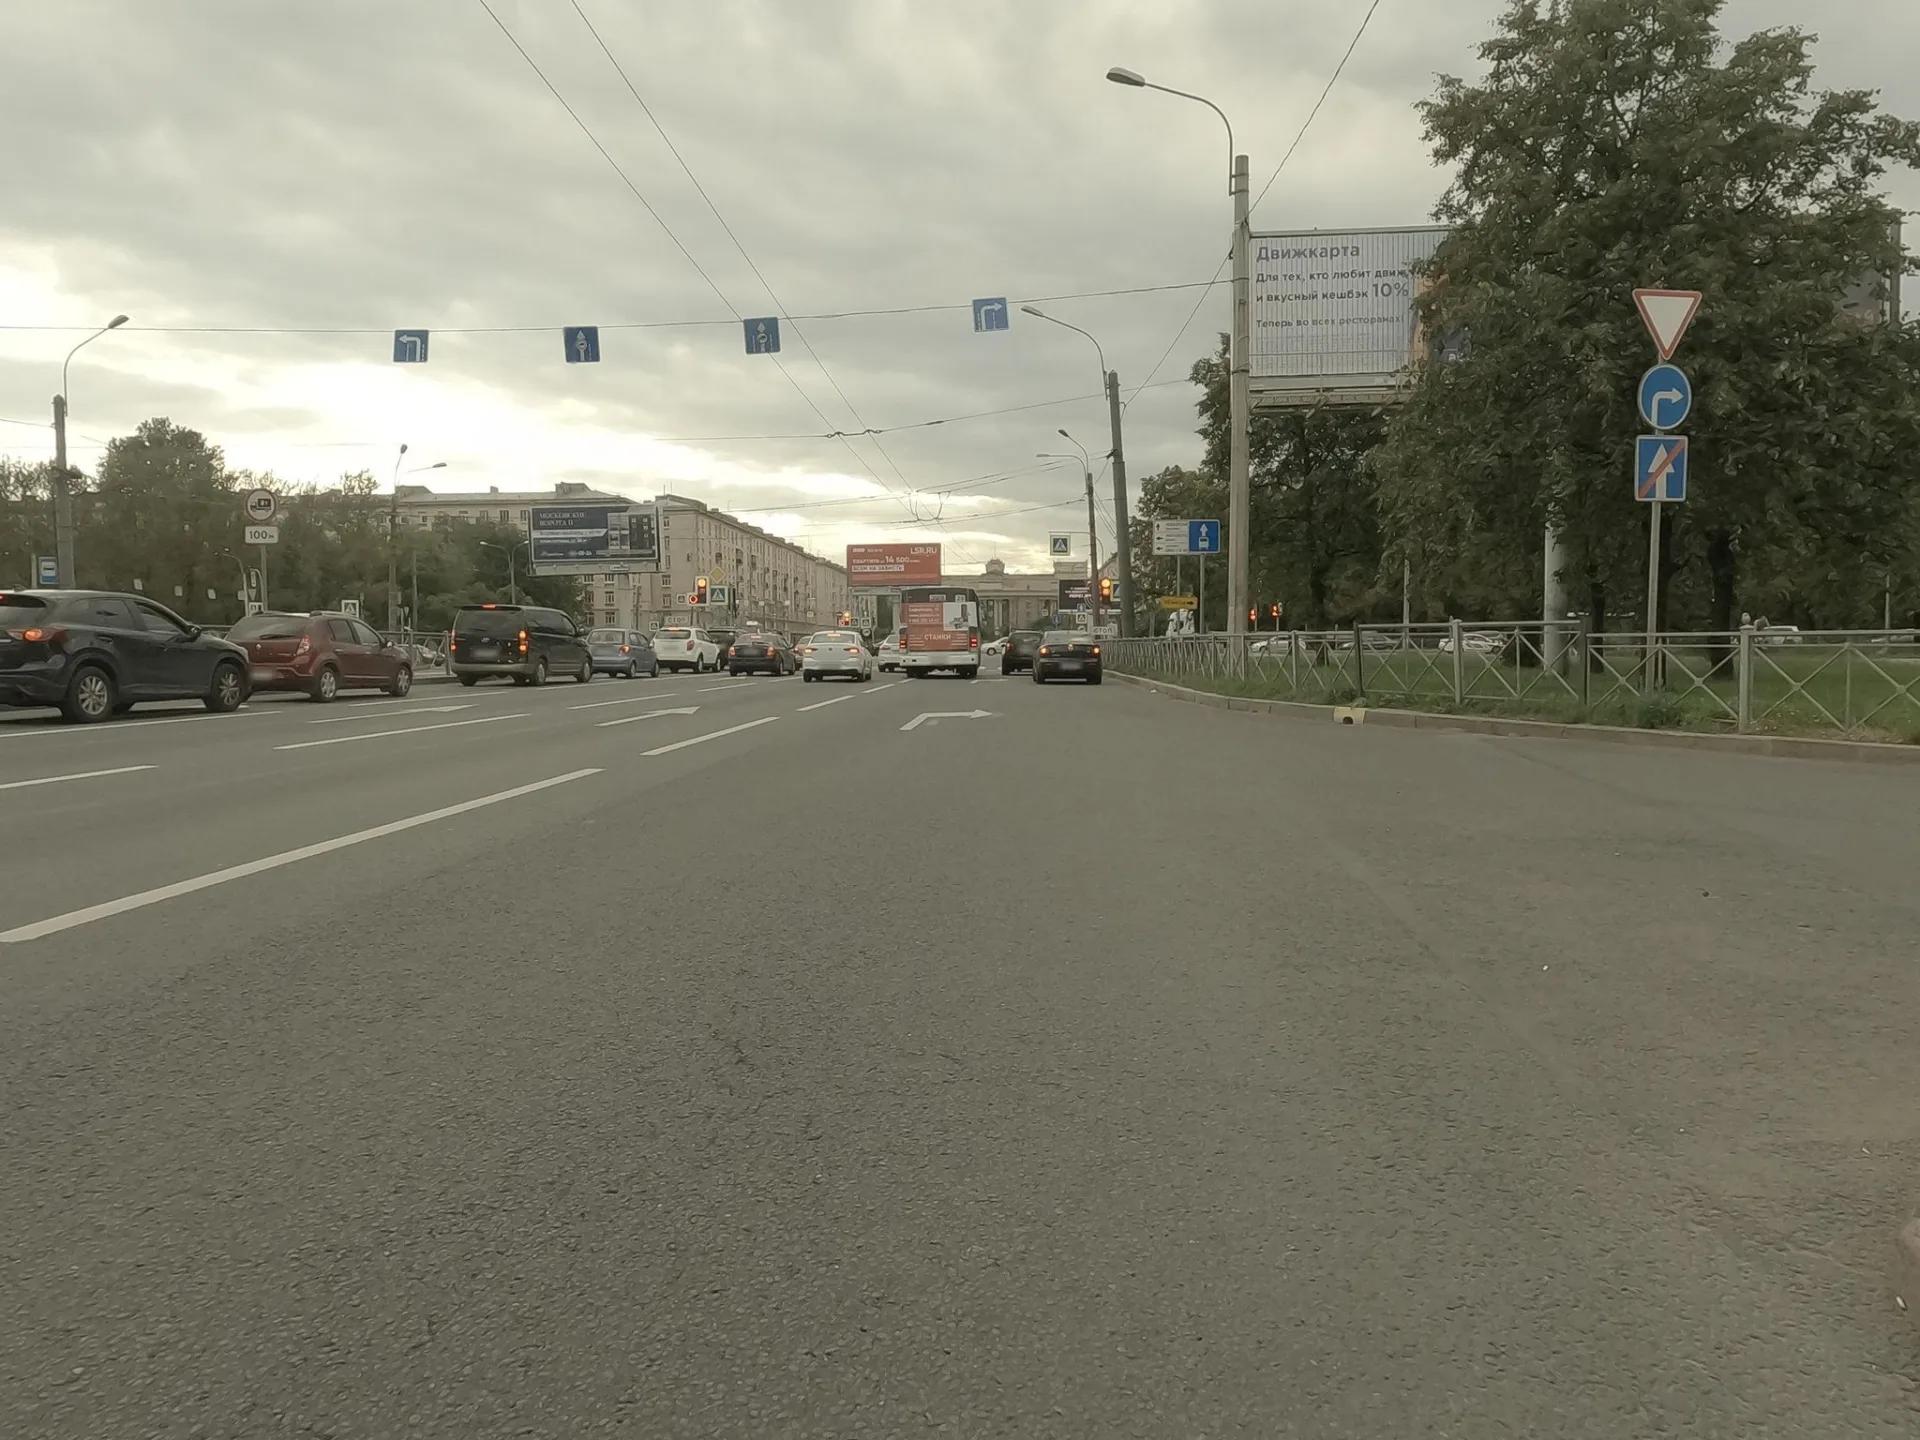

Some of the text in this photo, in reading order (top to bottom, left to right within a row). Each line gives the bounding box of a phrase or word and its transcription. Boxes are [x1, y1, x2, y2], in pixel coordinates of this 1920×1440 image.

[1257, 245, 1360, 262] Движкарта
[1256, 273, 1279, 283] Для
[1283, 272, 1306, 283] тех,
[1309, 271, 1329, 280] кто
[1332, 269, 1371, 280] любит
[1266, 290, 1318, 303] вкусный
[1322, 289, 1368, 300] кешбэк
[1372, 282, 1409, 298] 10%
[1256, 319, 1293, 329] Теперь
[1297, 319, 1309, 327] во
[1312, 317, 1336, 326] всех
[249, 530, 267, 539] 100
[924, 633, 951, 641] СТАНКИ
